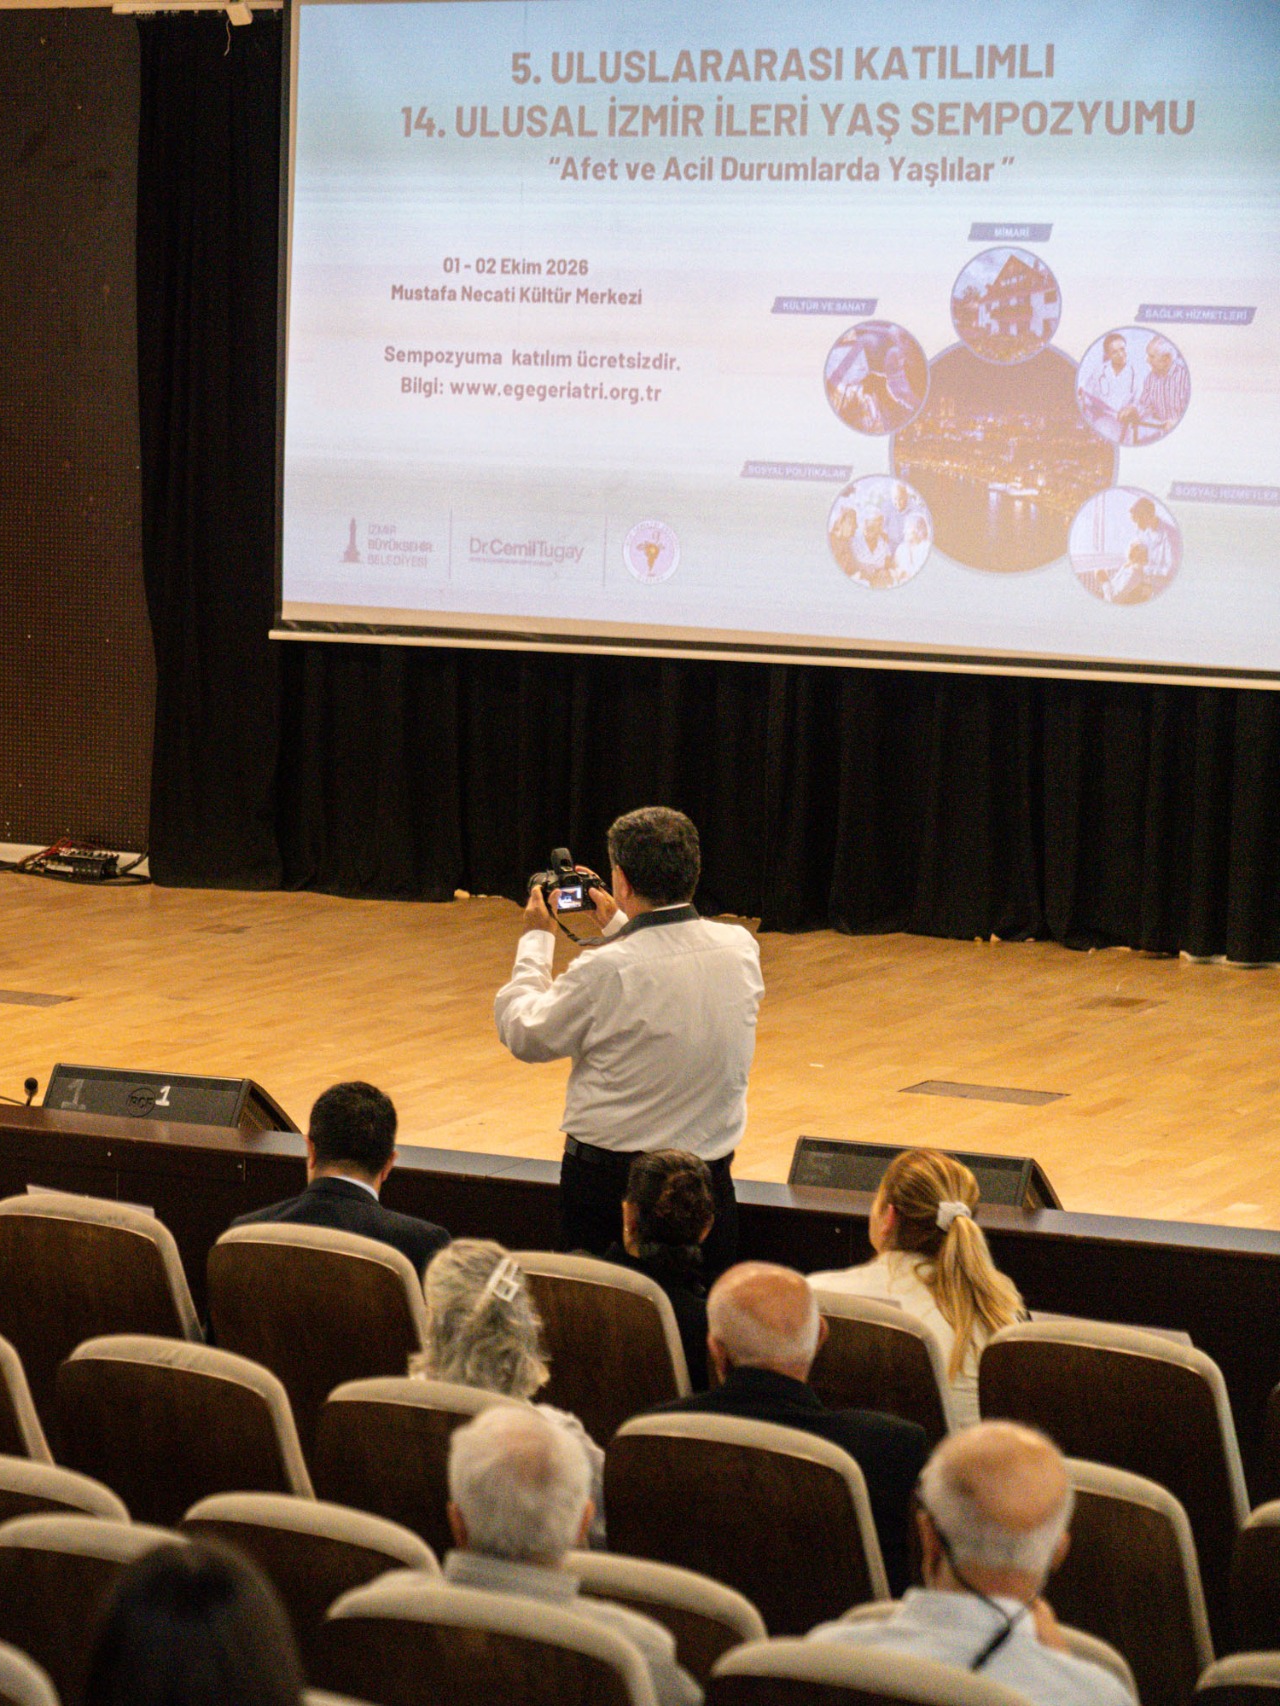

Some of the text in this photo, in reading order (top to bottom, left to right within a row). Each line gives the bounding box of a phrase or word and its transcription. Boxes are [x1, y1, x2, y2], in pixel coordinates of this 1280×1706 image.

[511, 43, 1055, 84] 5. ULUSLARARASI KATILIMLI
[401, 94, 1195, 145] 14. ULUSAL İZMİR İLERİ YAŞ SEMPOZYUMU
[626, 162, 655, 181] ve
[663, 156, 713, 181] Acil
[721, 156, 879, 182] Durumlarda
[888, 156, 994, 187] Yaşlılar
[443, 257, 460, 273] 01
[475, 258, 496, 274] 02
[501, 258, 542, 275] Ekim
[546, 259, 589, 276] 2026
[391, 284, 642, 305] Mustafa Necati Kültür Merkezi
[384, 346, 681, 371] Sempozyuma katılım ücretsizdir.
[401, 377, 662, 404] Bilgi: www.egegeriatri.org.tr
[155, 1085, 171, 1106] 1
